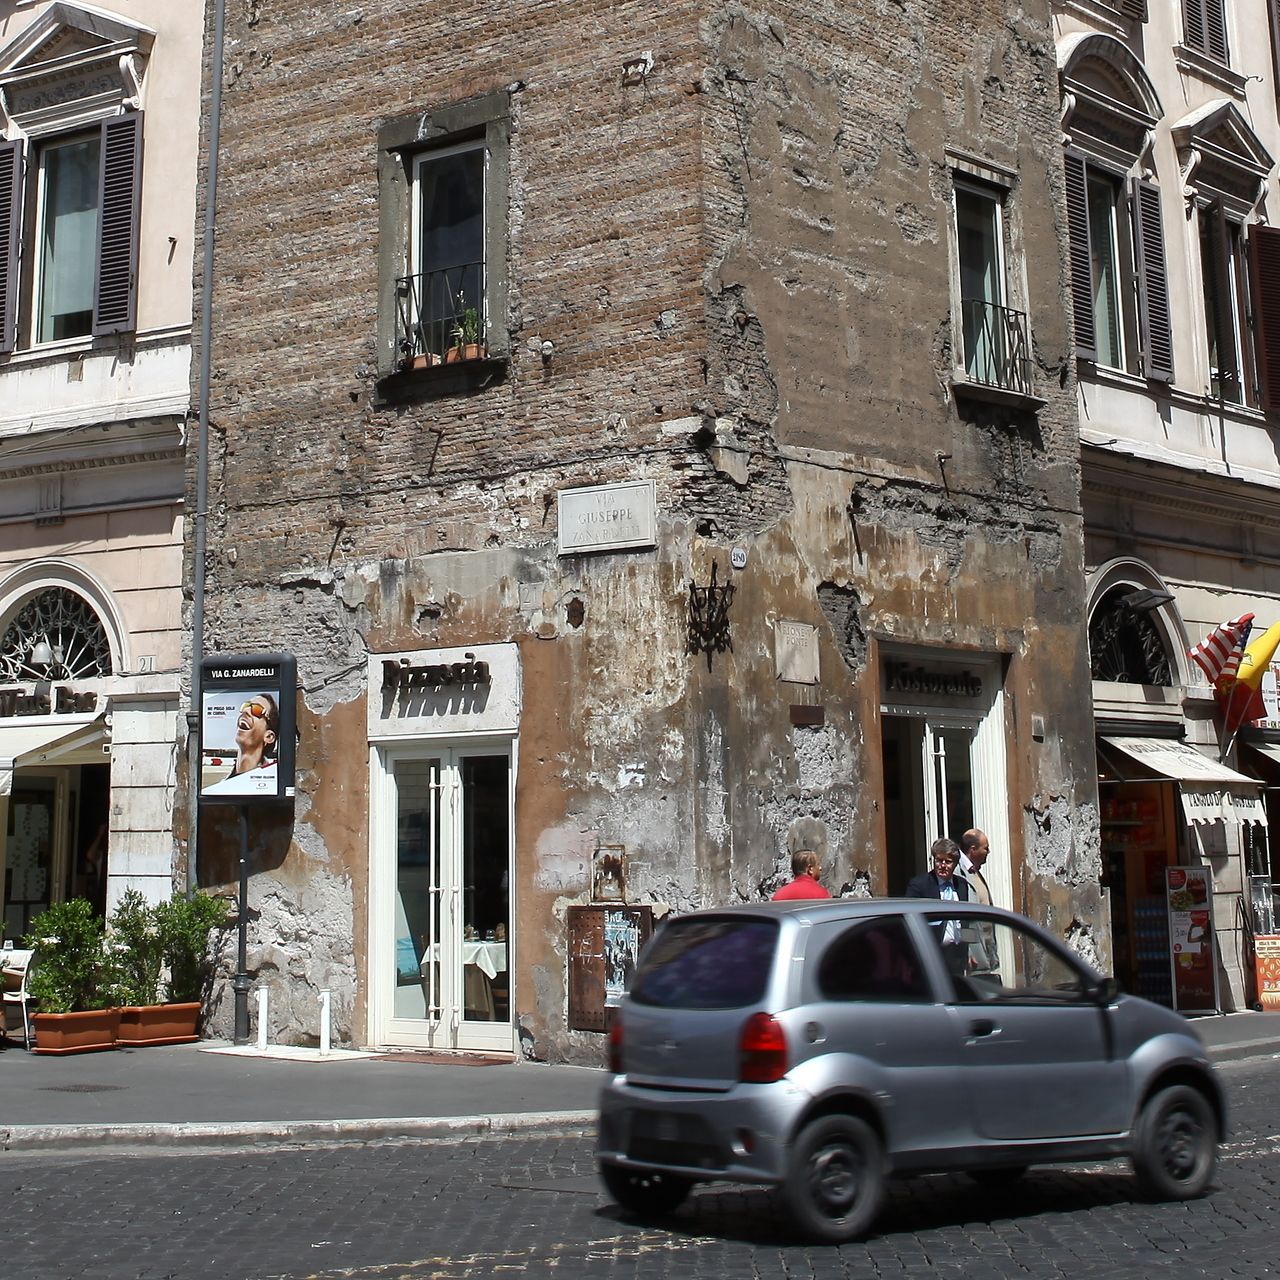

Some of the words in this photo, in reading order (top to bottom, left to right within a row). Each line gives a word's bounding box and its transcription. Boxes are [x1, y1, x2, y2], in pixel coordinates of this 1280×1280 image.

[595, 493, 616, 505] VIA
[578, 508, 633, 524] GIUSEPPE
[571, 525, 640, 543] ZANARDELLI
[786, 637, 808, 647] PONTE
[139, 657, 154, 671] 21
[381, 652, 492, 688] Pizzeria
[211, 670, 223, 679] VIA
[223, 670, 232, 678] G.
[232, 668, 275, 678] ZANARDELLI
[884, 658, 983, 698] Ristorante
[53, 686, 99, 713] Bar
